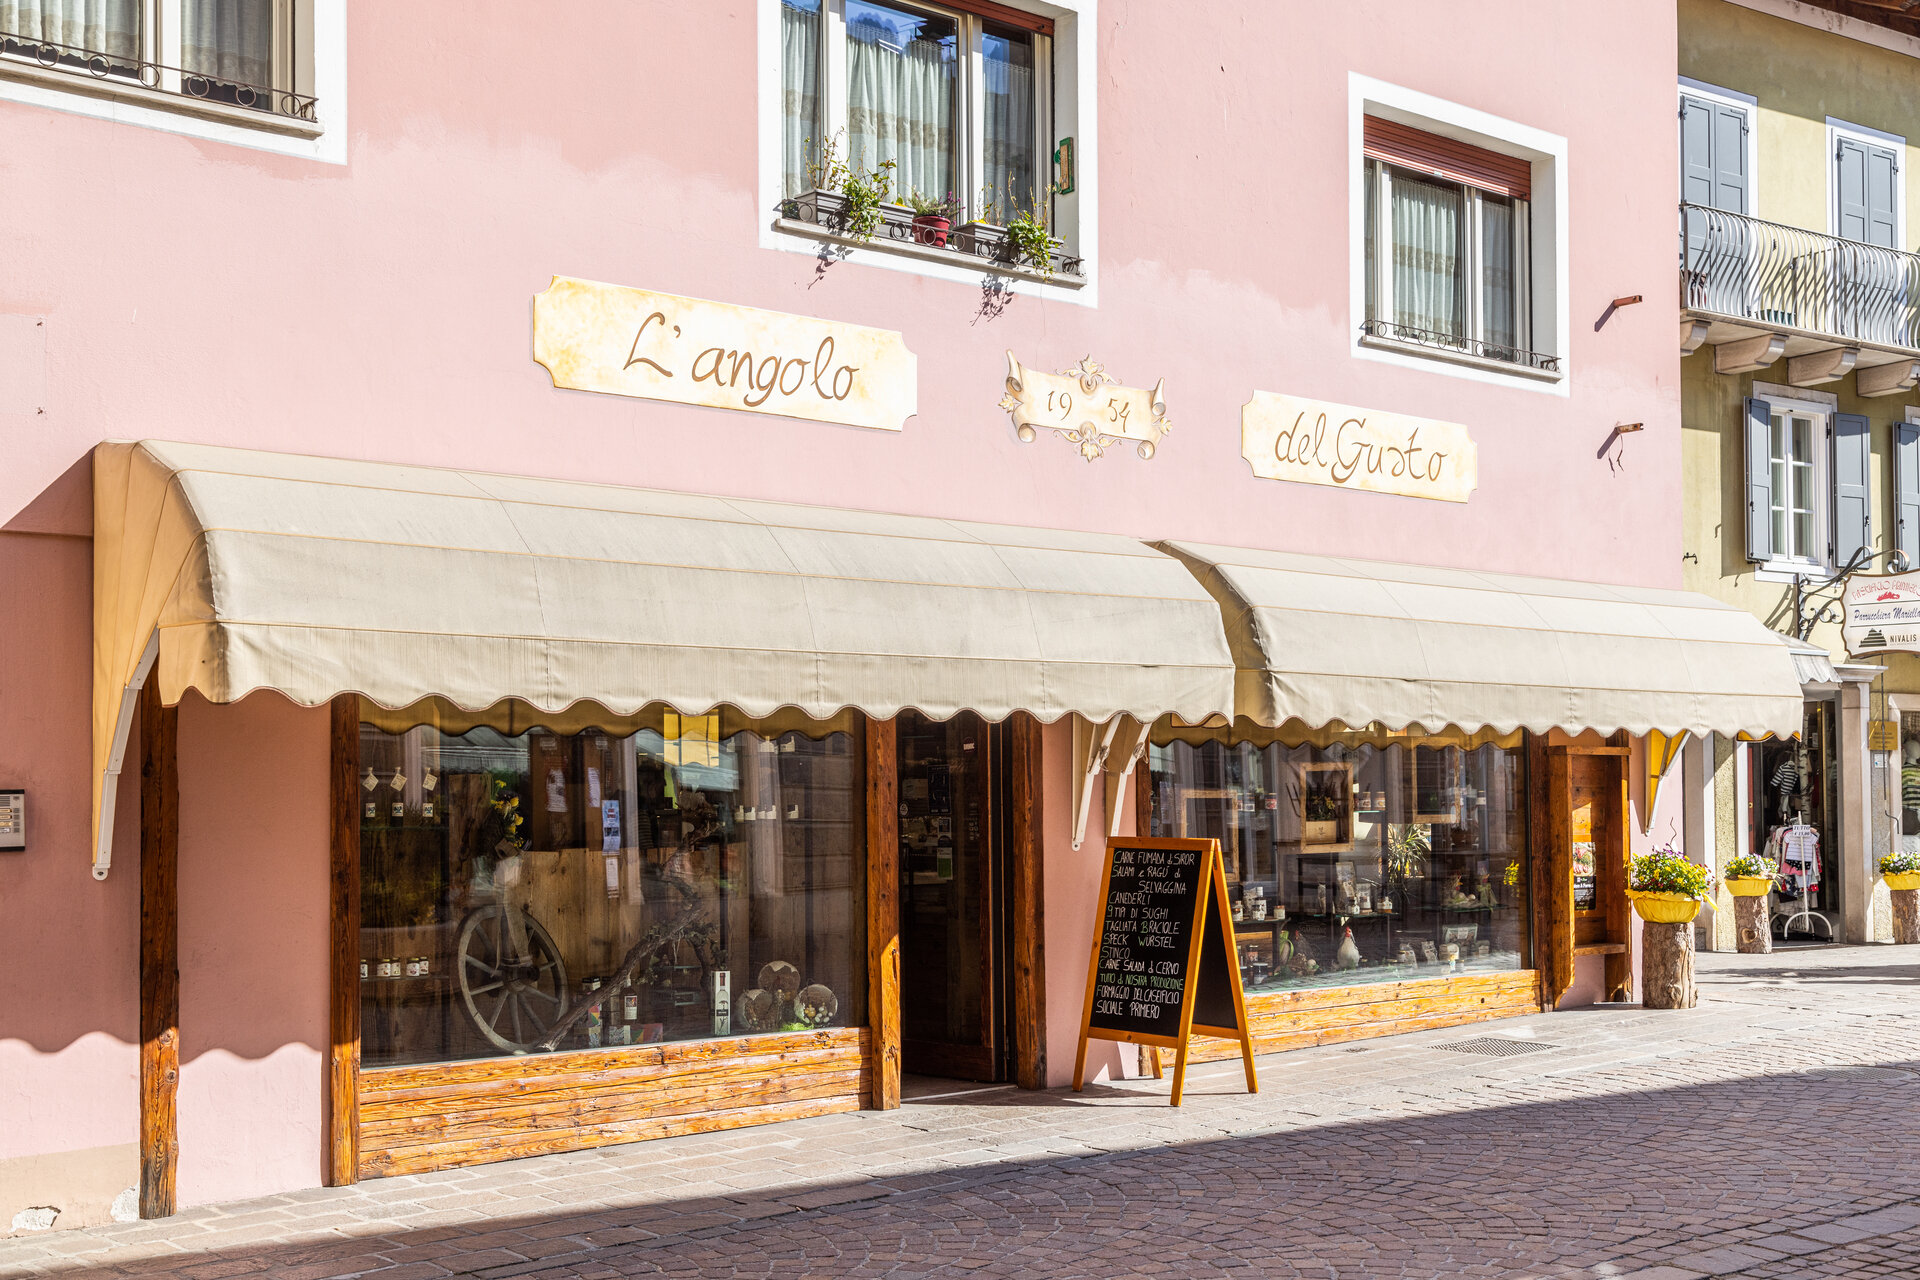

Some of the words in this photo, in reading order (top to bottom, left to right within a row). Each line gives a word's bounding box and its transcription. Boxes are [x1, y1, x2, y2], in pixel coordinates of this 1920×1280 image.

[1275, 411, 1328, 467] del
[1331, 418, 1448, 484] Gusto
[1890, 634, 1917, 643] NIVALIS
[1114, 851, 1134, 863] CARNE
[1138, 852, 1165, 864] FUMADA
[1112, 865, 1134, 877] SALAMI
[1138, 880, 1187, 894] SELVAGGINA
[1109, 891, 1150, 905] CANEDERLI
[1115, 907, 1126, 917] TIPI
[1131, 908, 1138, 918] DI
[1141, 907, 1168, 919] SUGHI
[1105, 920, 1137, 932] TAGLIATA
[1141, 920, 1180, 934] BRACIOLE
[1103, 933, 1130, 945] SPECK
[1100, 946, 1130, 959] STINCO
[1099, 959, 1121, 970] CARNE
[1123, 959, 1145, 971] SALADA
[1156, 961, 1180, 975] CERVO
[1100, 973, 1116, 983] TUTTO
[1125, 974, 1147, 986] NOSTRA
[1150, 976, 1183, 990] PRODUZIONE
[1097, 985, 1130, 999] FORMAGGIO
[1134, 988, 1143, 1001] DEL
[1144, 989, 1180, 1004] CASEIFICIO
[1096, 1000, 1123, 1015] SOCIALE
[1129, 1002, 1160, 1019] PRIMIERO
